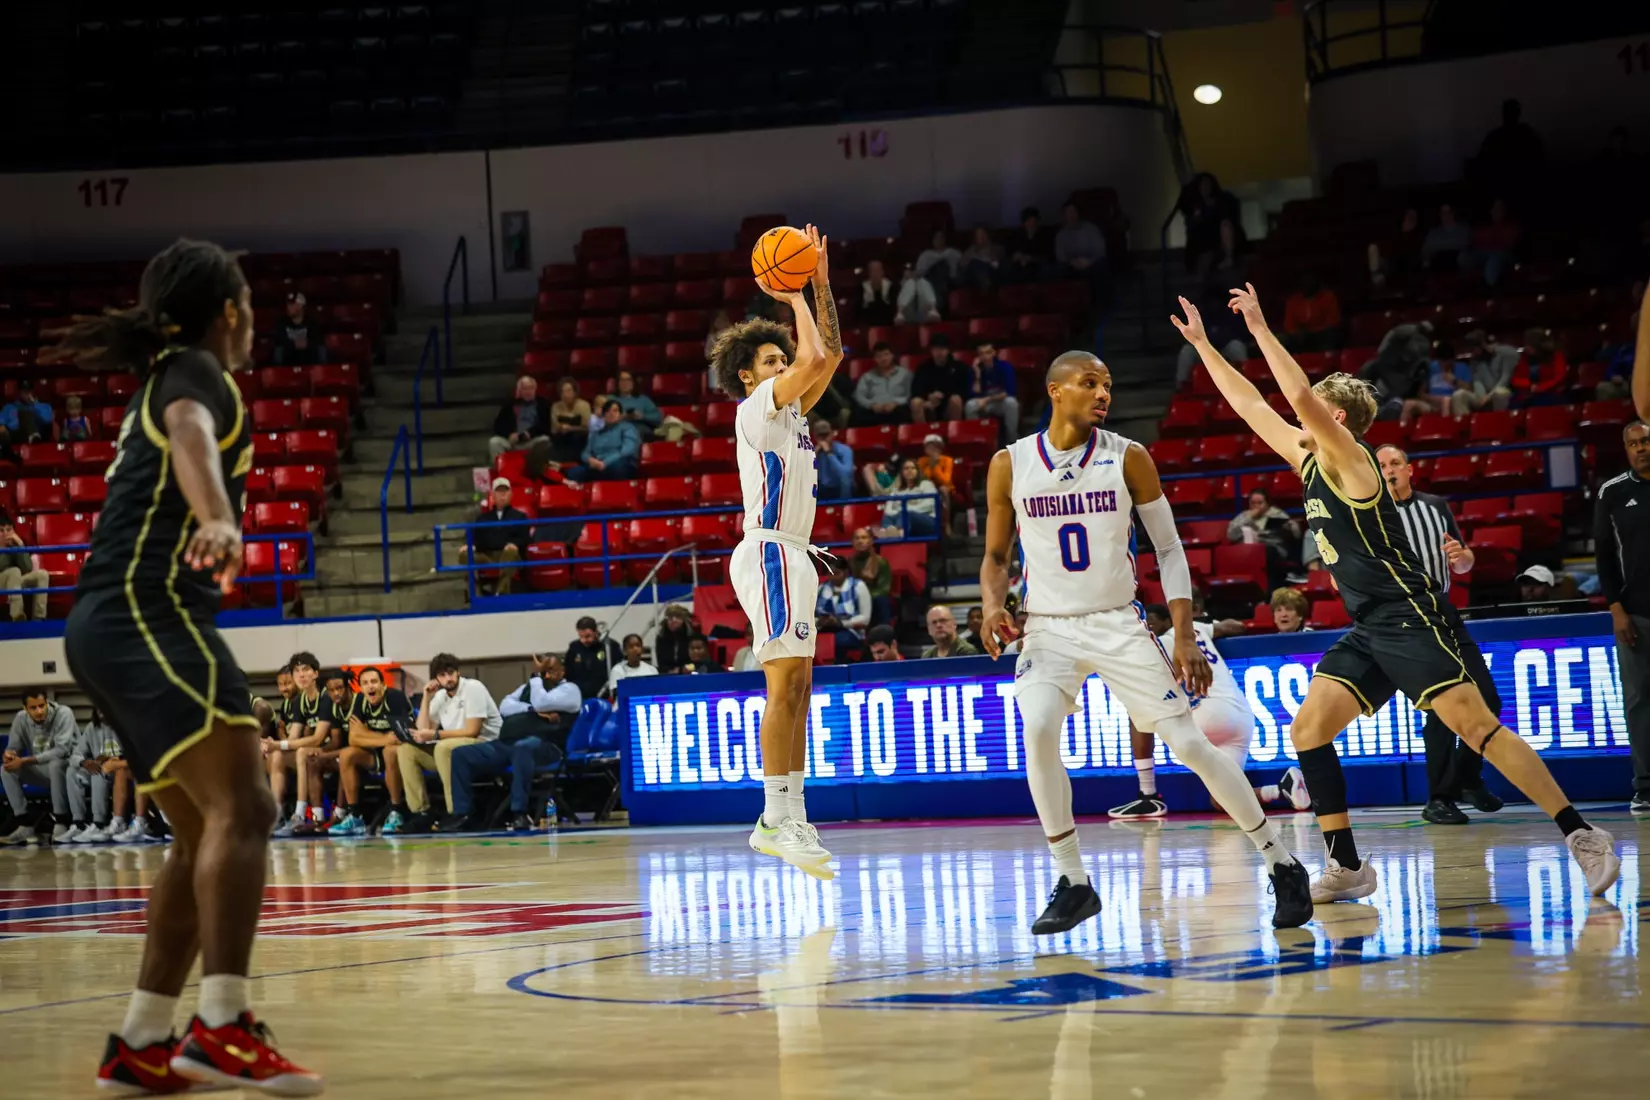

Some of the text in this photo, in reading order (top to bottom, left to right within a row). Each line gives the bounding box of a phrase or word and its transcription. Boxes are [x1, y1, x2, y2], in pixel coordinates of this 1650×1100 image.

[78, 177, 129, 207] 117
[1023, 490, 1117, 518] LOUISIANA TECH
[1058, 522, 1091, 572] 0
[636, 693, 836, 784] WELCOE
[843, 688, 898, 777] TO
[906, 684, 988, 774] THE
